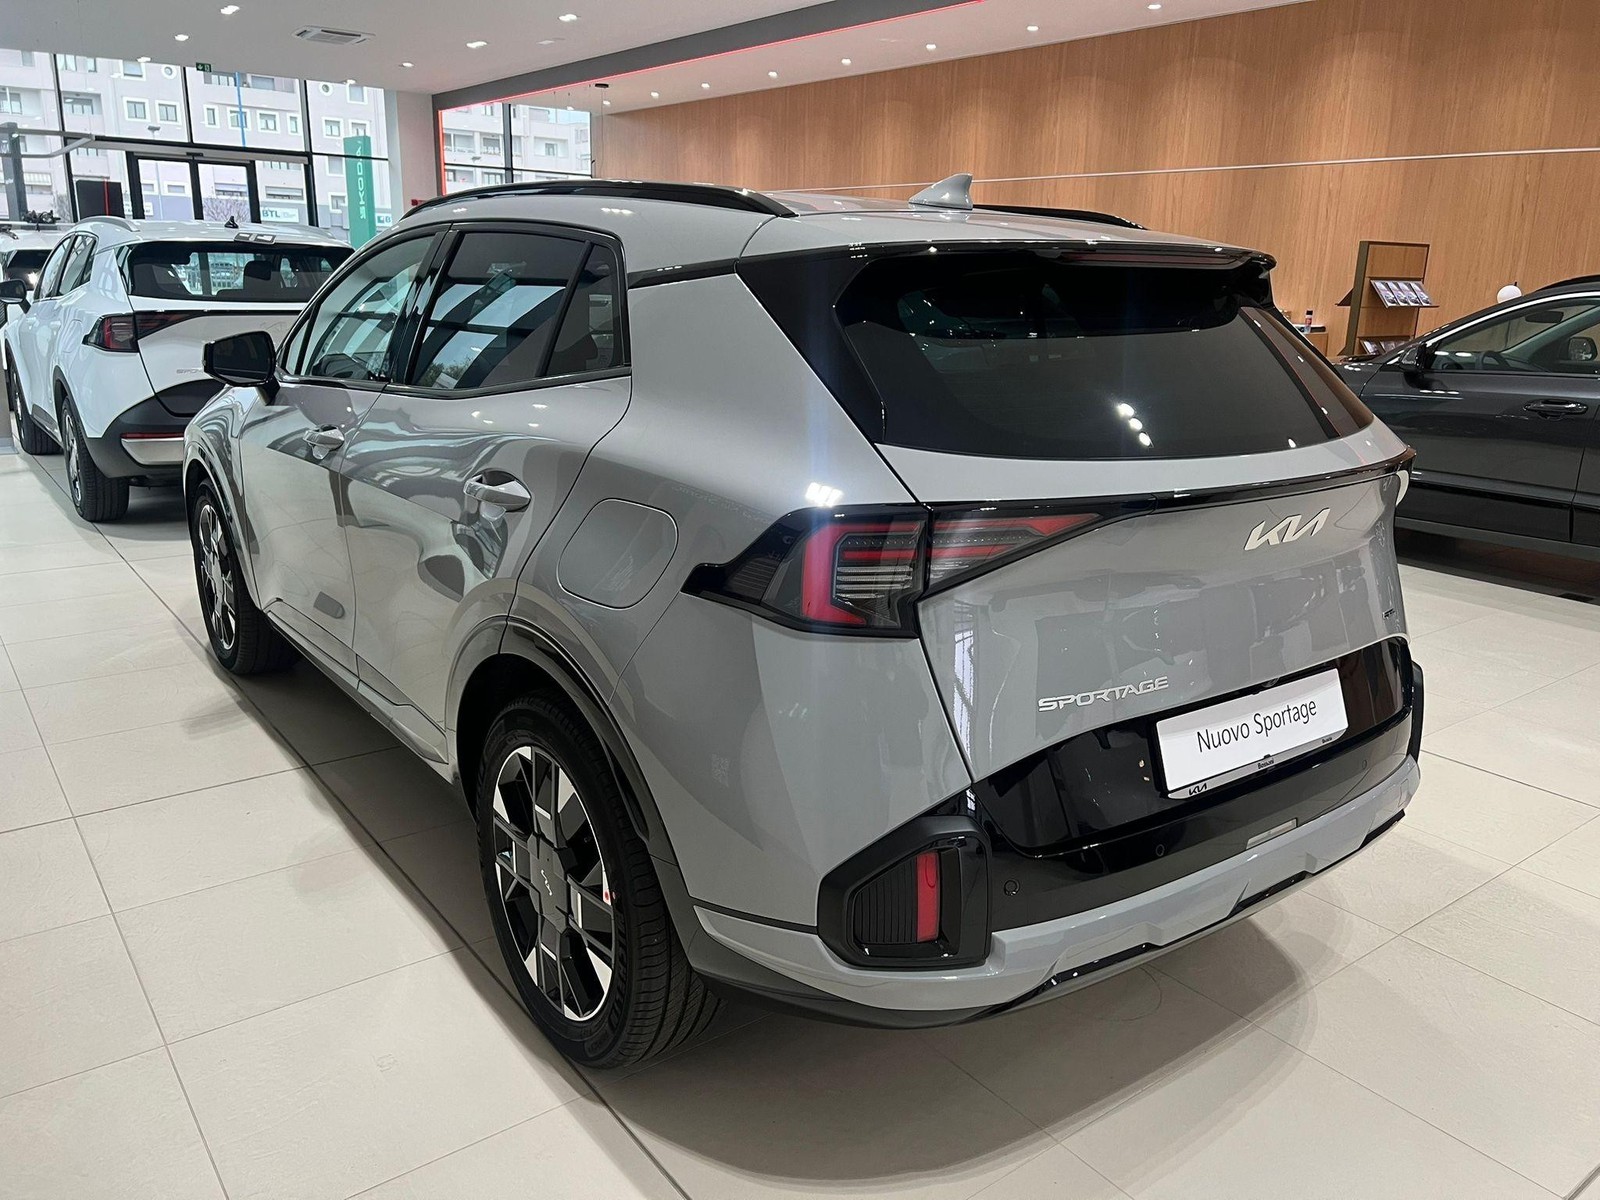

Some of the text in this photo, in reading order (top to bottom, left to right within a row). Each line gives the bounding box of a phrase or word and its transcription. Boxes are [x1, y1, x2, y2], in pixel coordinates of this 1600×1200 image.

[1244, 508, 1330, 551] KIA
[1038, 676, 1169, 712] SPORTAGE
[1196, 700, 1317, 752] Nuovo Sportage
